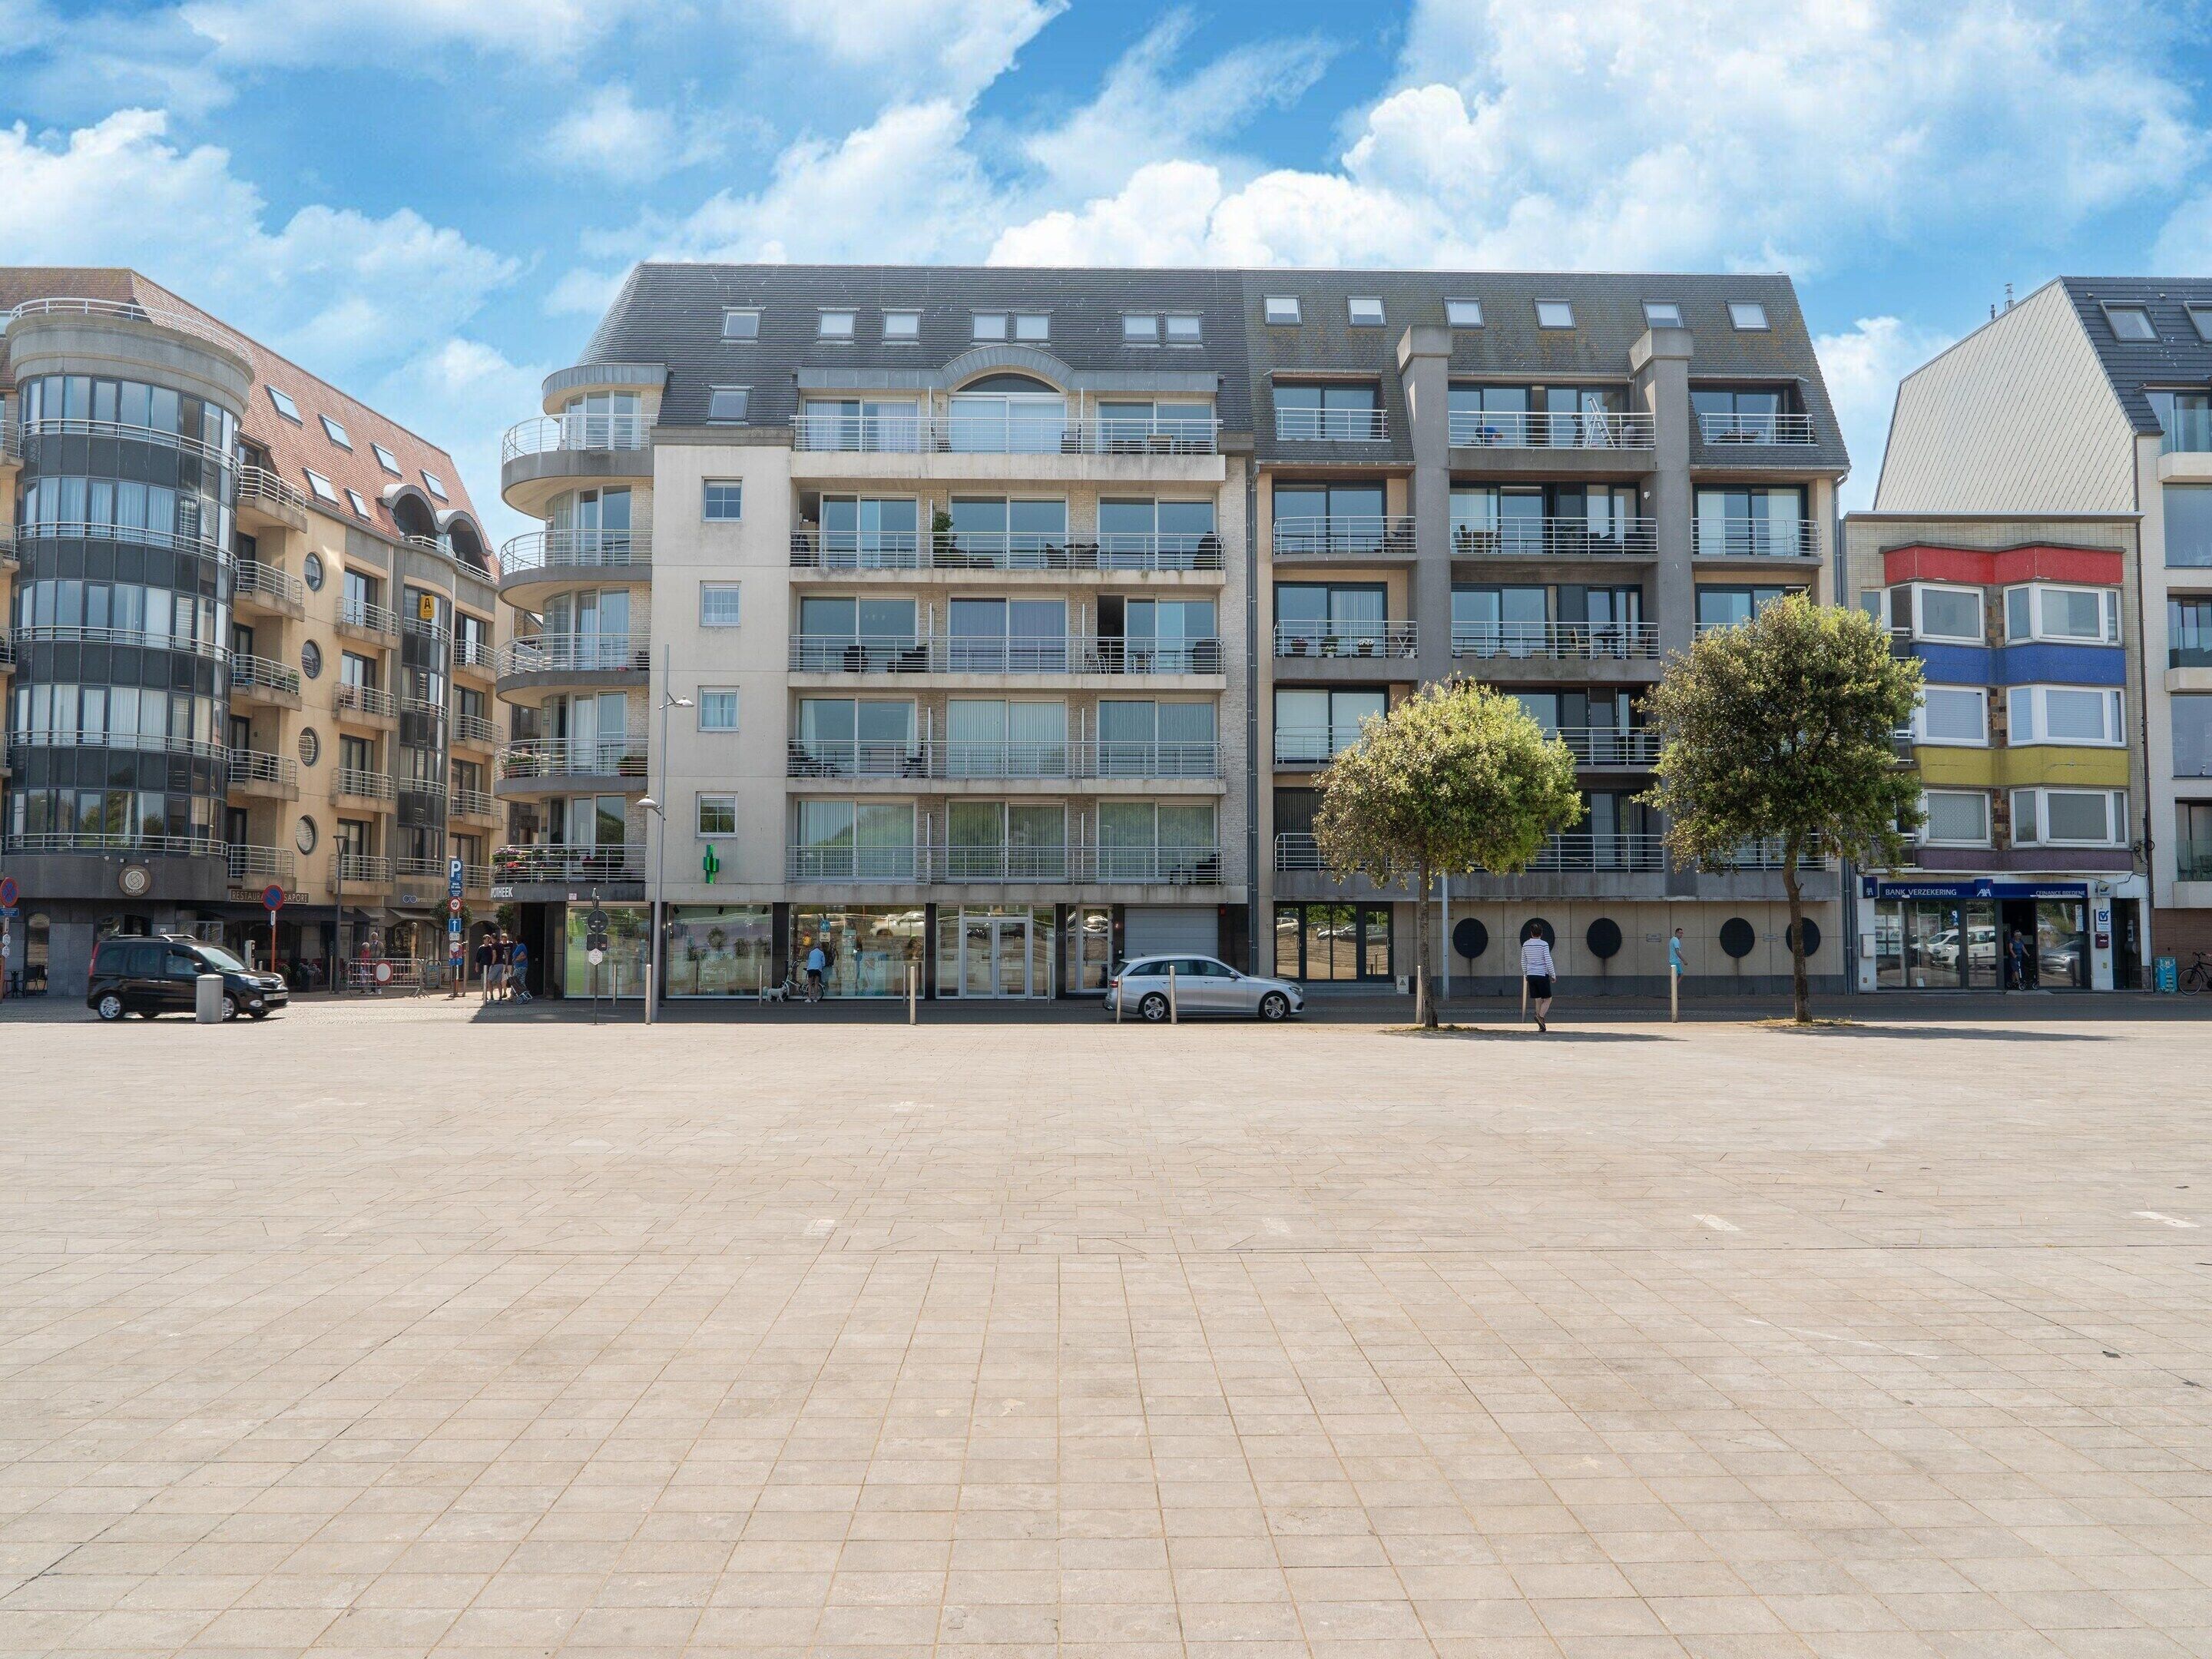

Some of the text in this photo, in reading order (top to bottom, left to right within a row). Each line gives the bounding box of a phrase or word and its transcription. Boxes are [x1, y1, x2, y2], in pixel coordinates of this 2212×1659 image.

[451, 860, 462, 878] P
[232, 891, 307, 902] RESTAUR SAPORI
[1976, 888, 1992, 897] AXA
